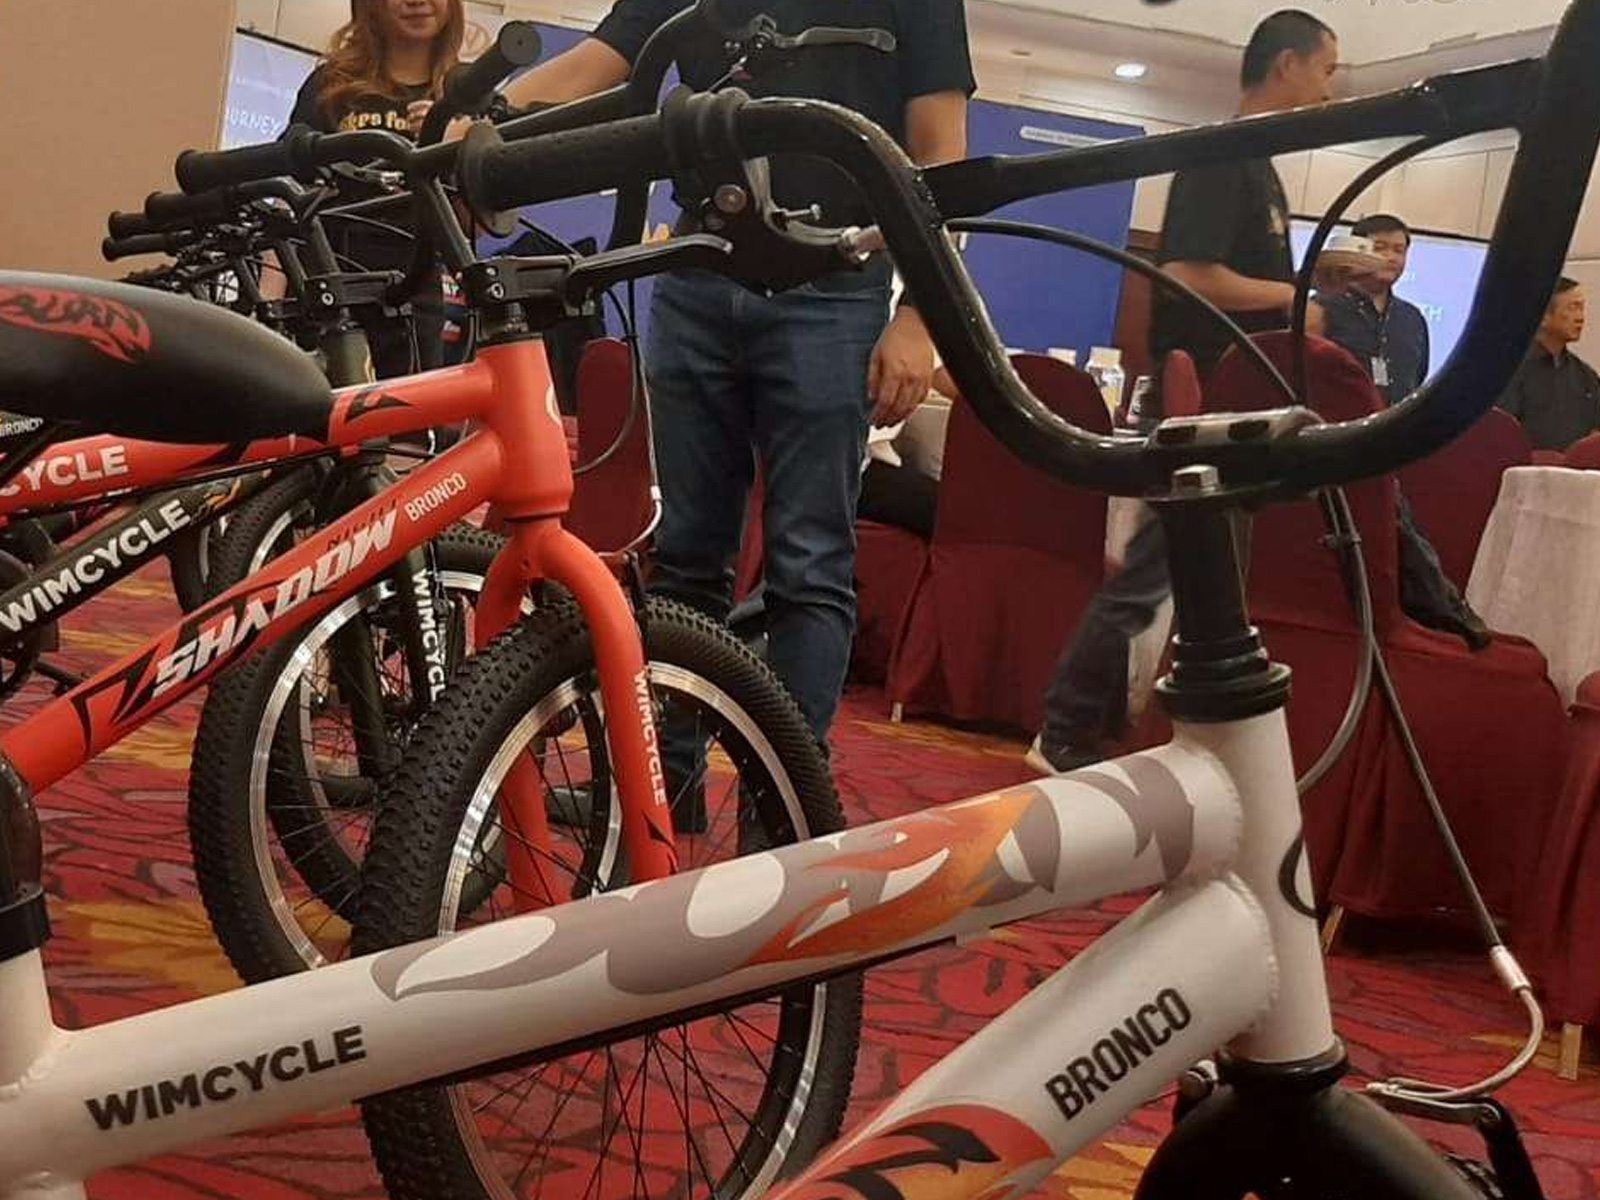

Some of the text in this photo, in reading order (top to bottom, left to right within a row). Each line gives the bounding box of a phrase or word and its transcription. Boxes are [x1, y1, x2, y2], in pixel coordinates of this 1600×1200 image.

[404, 472, 467, 521] BRONCO
[0, 499, 191, 632] WIMCYCLE
[152, 509, 397, 697] SHADOW
[634, 670, 667, 806] WIMCYCLE
[86, 1025, 367, 1130] WIMCYCLE
[1045, 988, 1191, 1121] BRONCO
